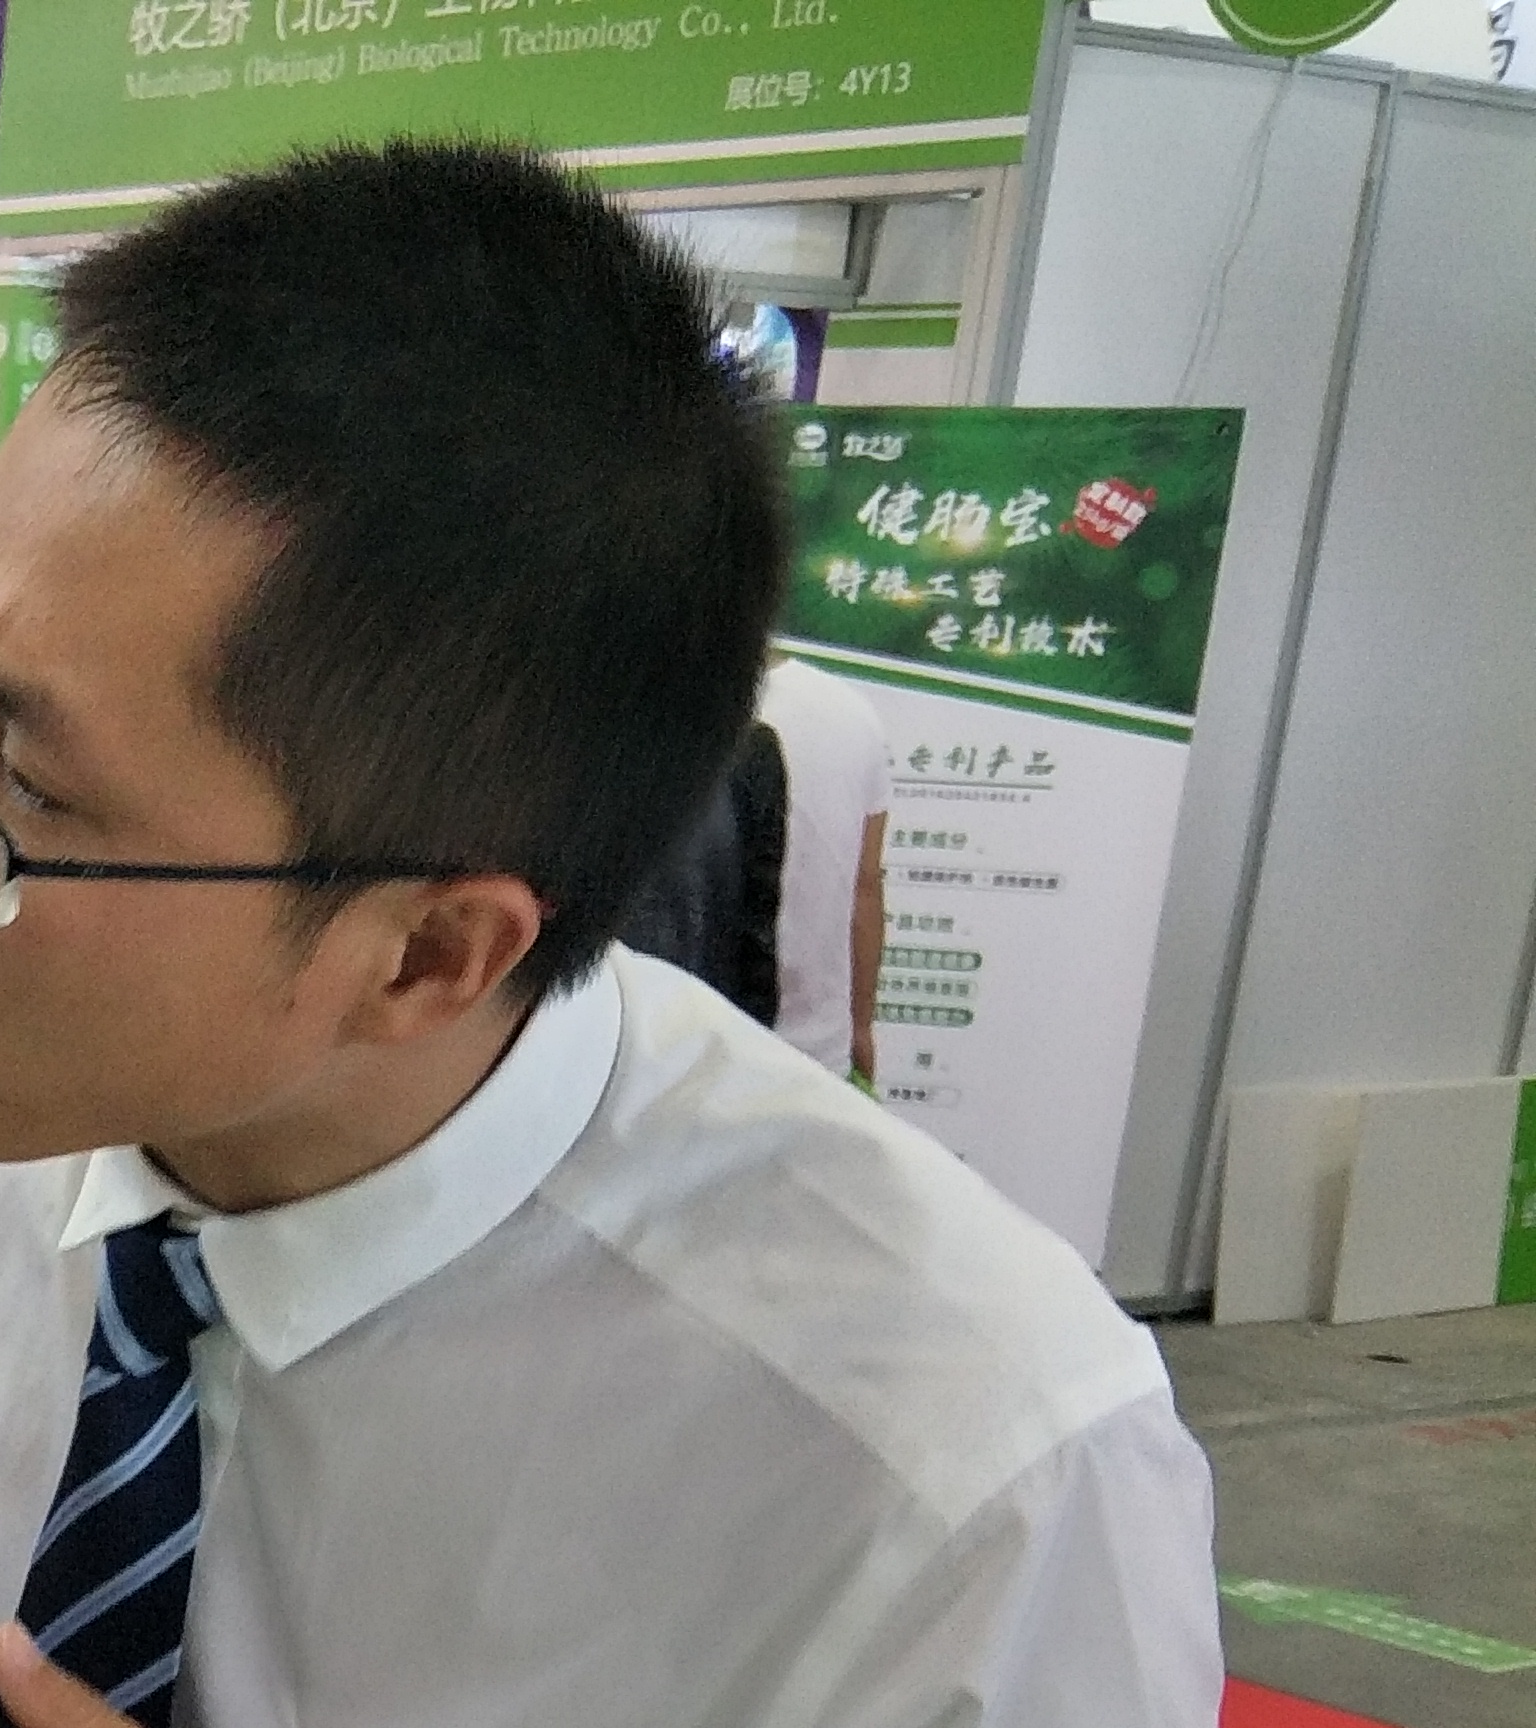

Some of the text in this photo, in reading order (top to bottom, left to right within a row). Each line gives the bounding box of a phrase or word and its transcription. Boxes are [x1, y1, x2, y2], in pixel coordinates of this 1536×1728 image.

[357, 32, 483, 75] Biological
[498, 14, 662, 57] Technology
[838, 61, 913, 96] 4Y13
[856, 482, 1052, 548] 健肠宝
[825, 556, 1007, 606] 特殊工艺
[926, 614, 1118, 658] 专利技术
